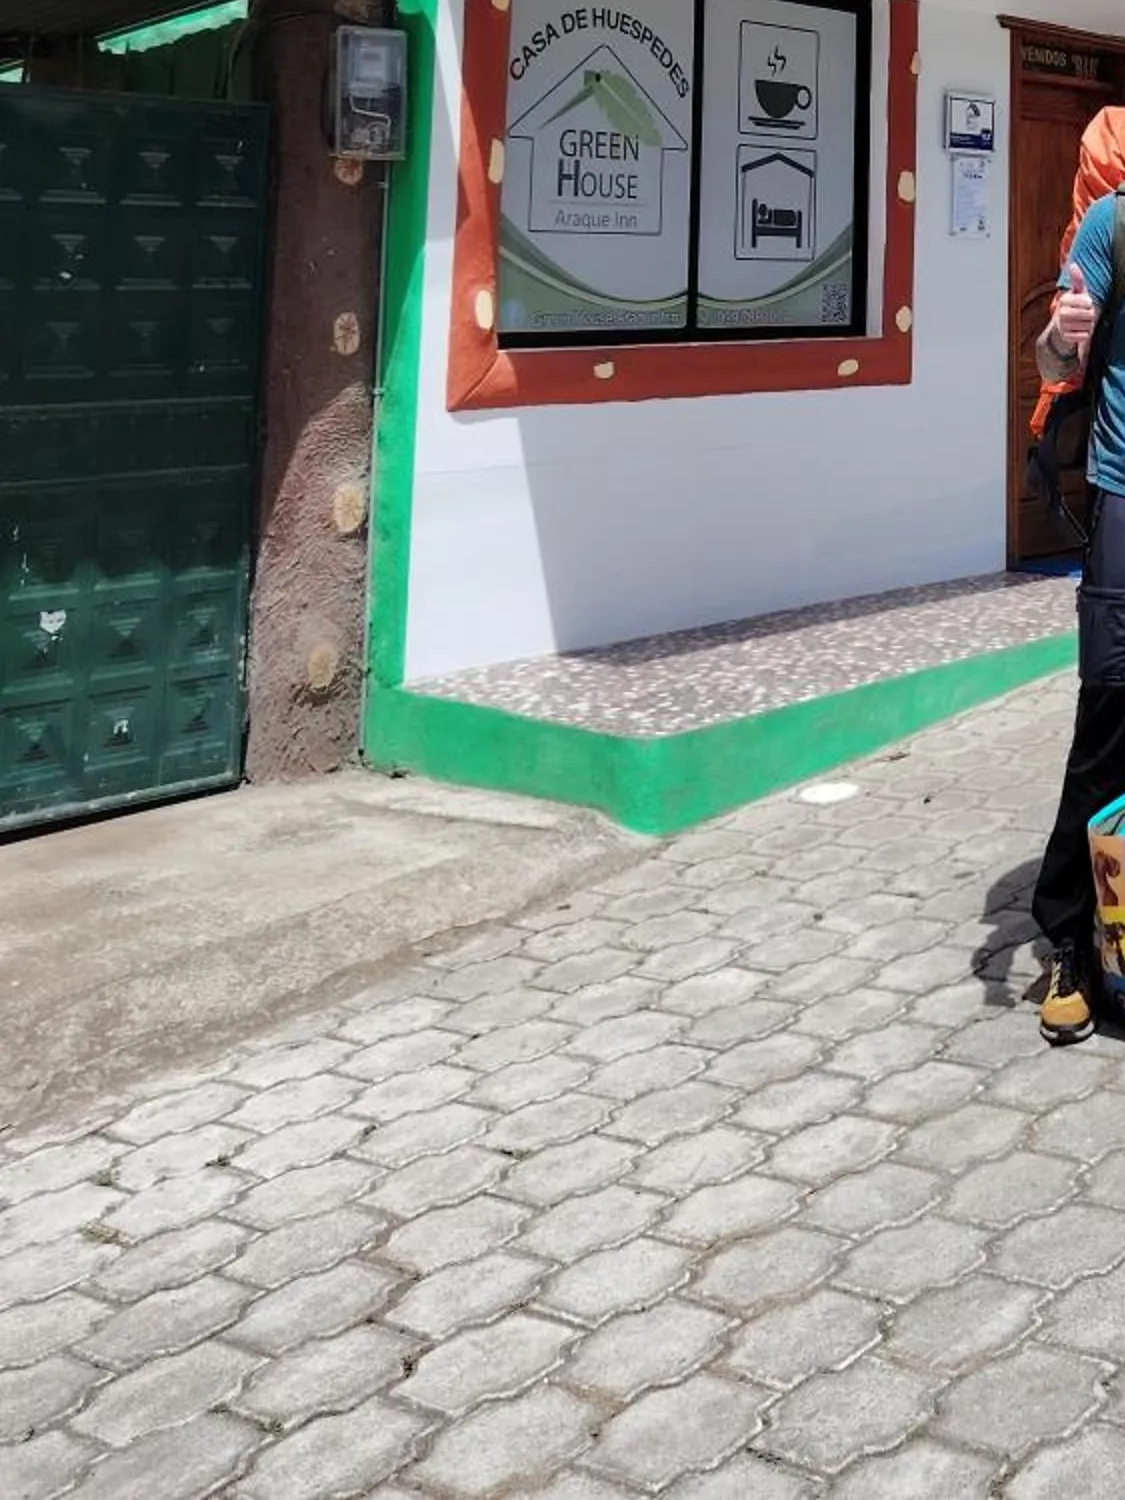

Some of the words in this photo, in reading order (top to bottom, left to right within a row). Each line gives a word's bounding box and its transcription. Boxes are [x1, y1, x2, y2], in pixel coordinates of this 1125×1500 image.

[509, 23, 561, 82] CASA
[560, 9, 588, 34] DE
[592, 7, 690, 99] HUESPEDES
[559, 129, 640, 161] GREEN
[557, 159, 638, 199] HOUSE
[554, 209, 611, 229] Araque
[615, 209, 637, 227] Inn
